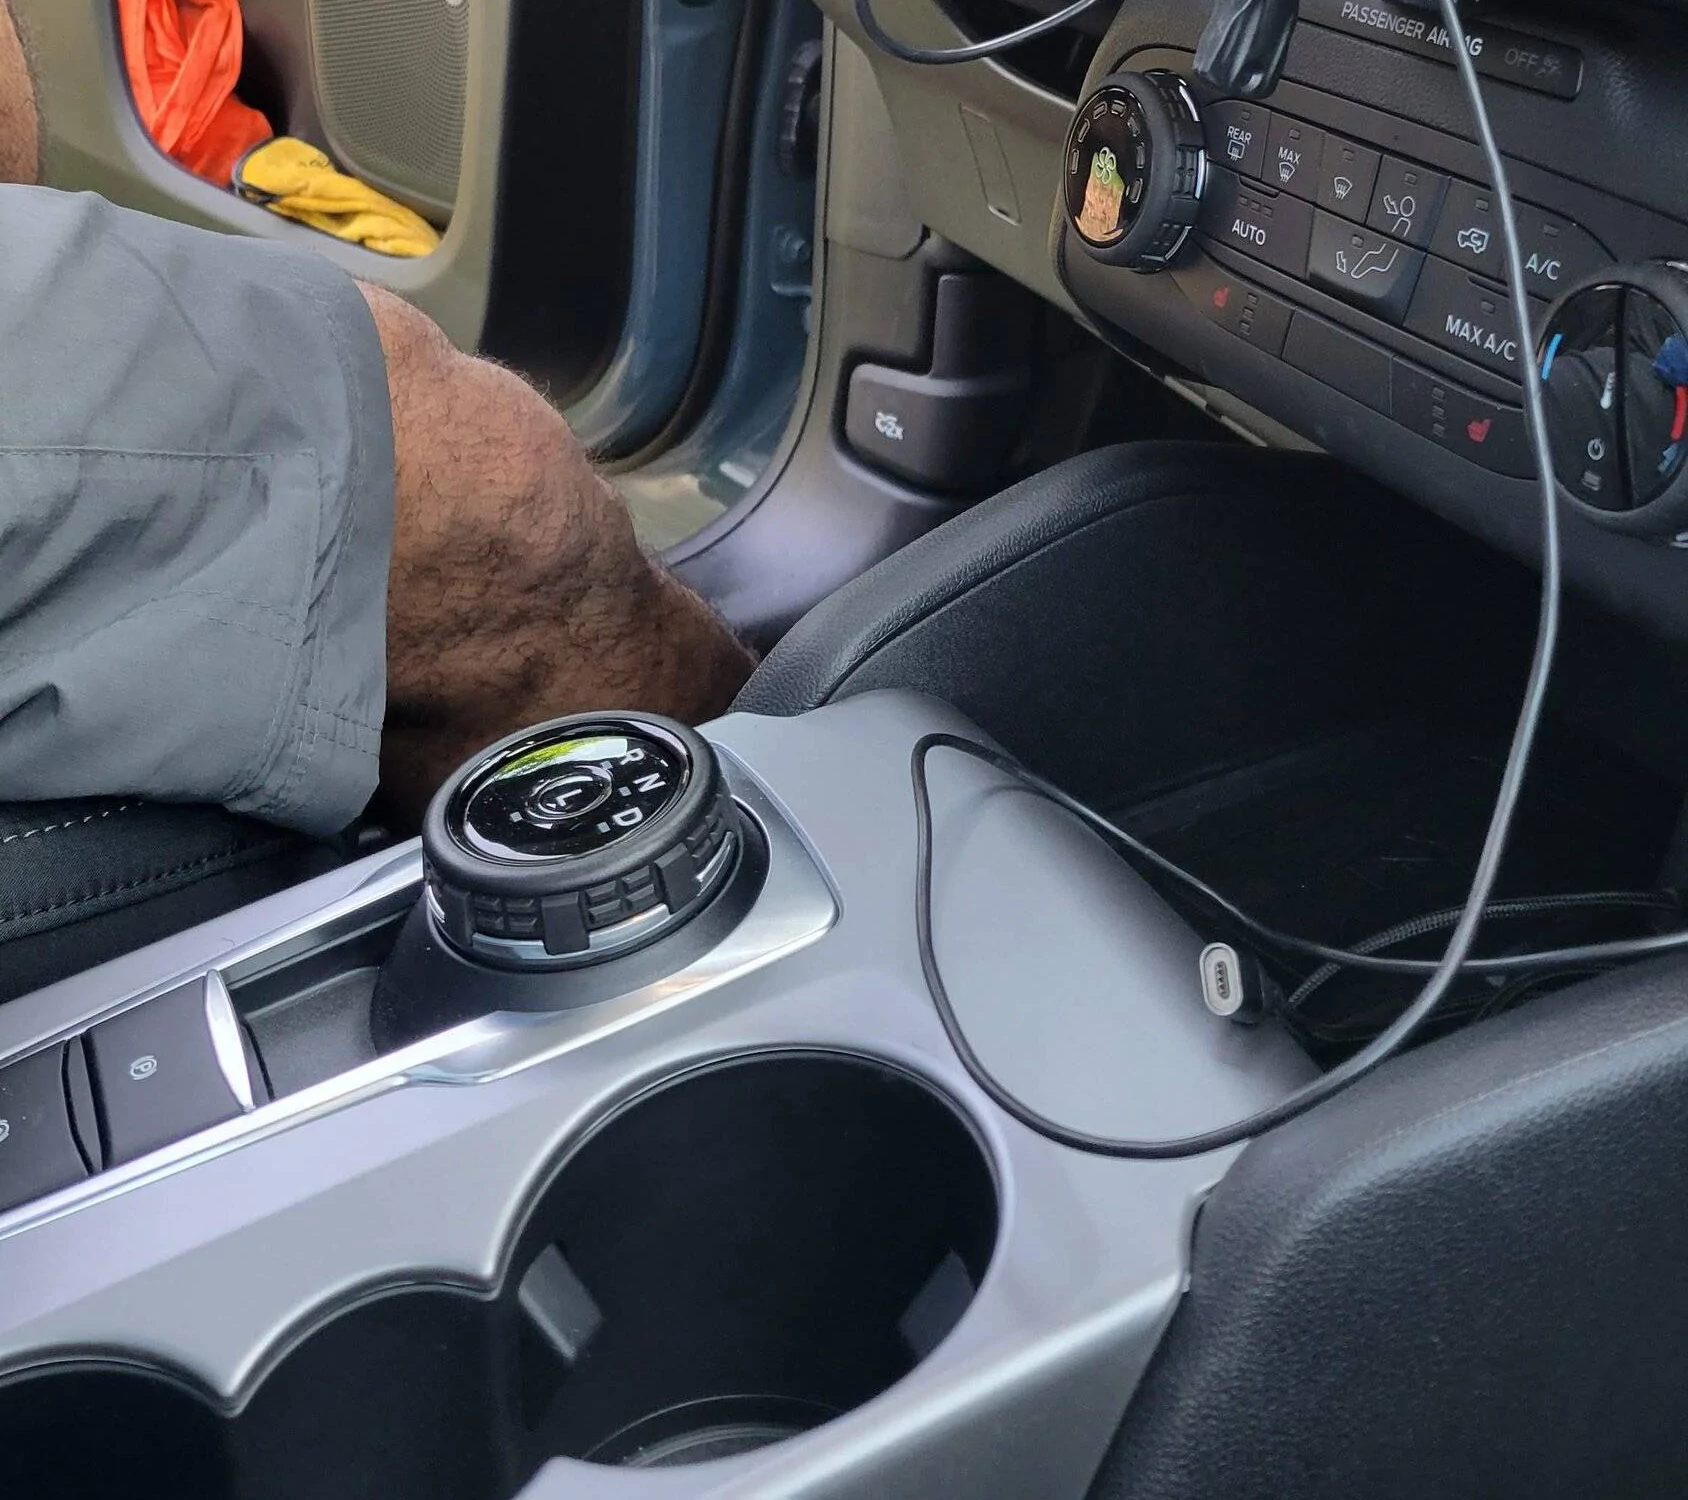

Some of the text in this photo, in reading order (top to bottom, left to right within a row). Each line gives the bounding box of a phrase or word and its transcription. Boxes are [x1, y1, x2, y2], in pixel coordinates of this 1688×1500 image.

[1341, 1, 1539, 71] PASSENGER AIRG OFF
[1227, 125, 1252, 145] REAR
[1278, 146, 1302, 166] MAX
[1231, 218, 1266, 246] AUTO
[1525, 253, 1561, 281] A/C
[1445, 314, 1518, 361] MAX A/C
[620, 747, 645, 766] R
[632, 772, 666, 793] N
[612, 806, 644, 827] D
